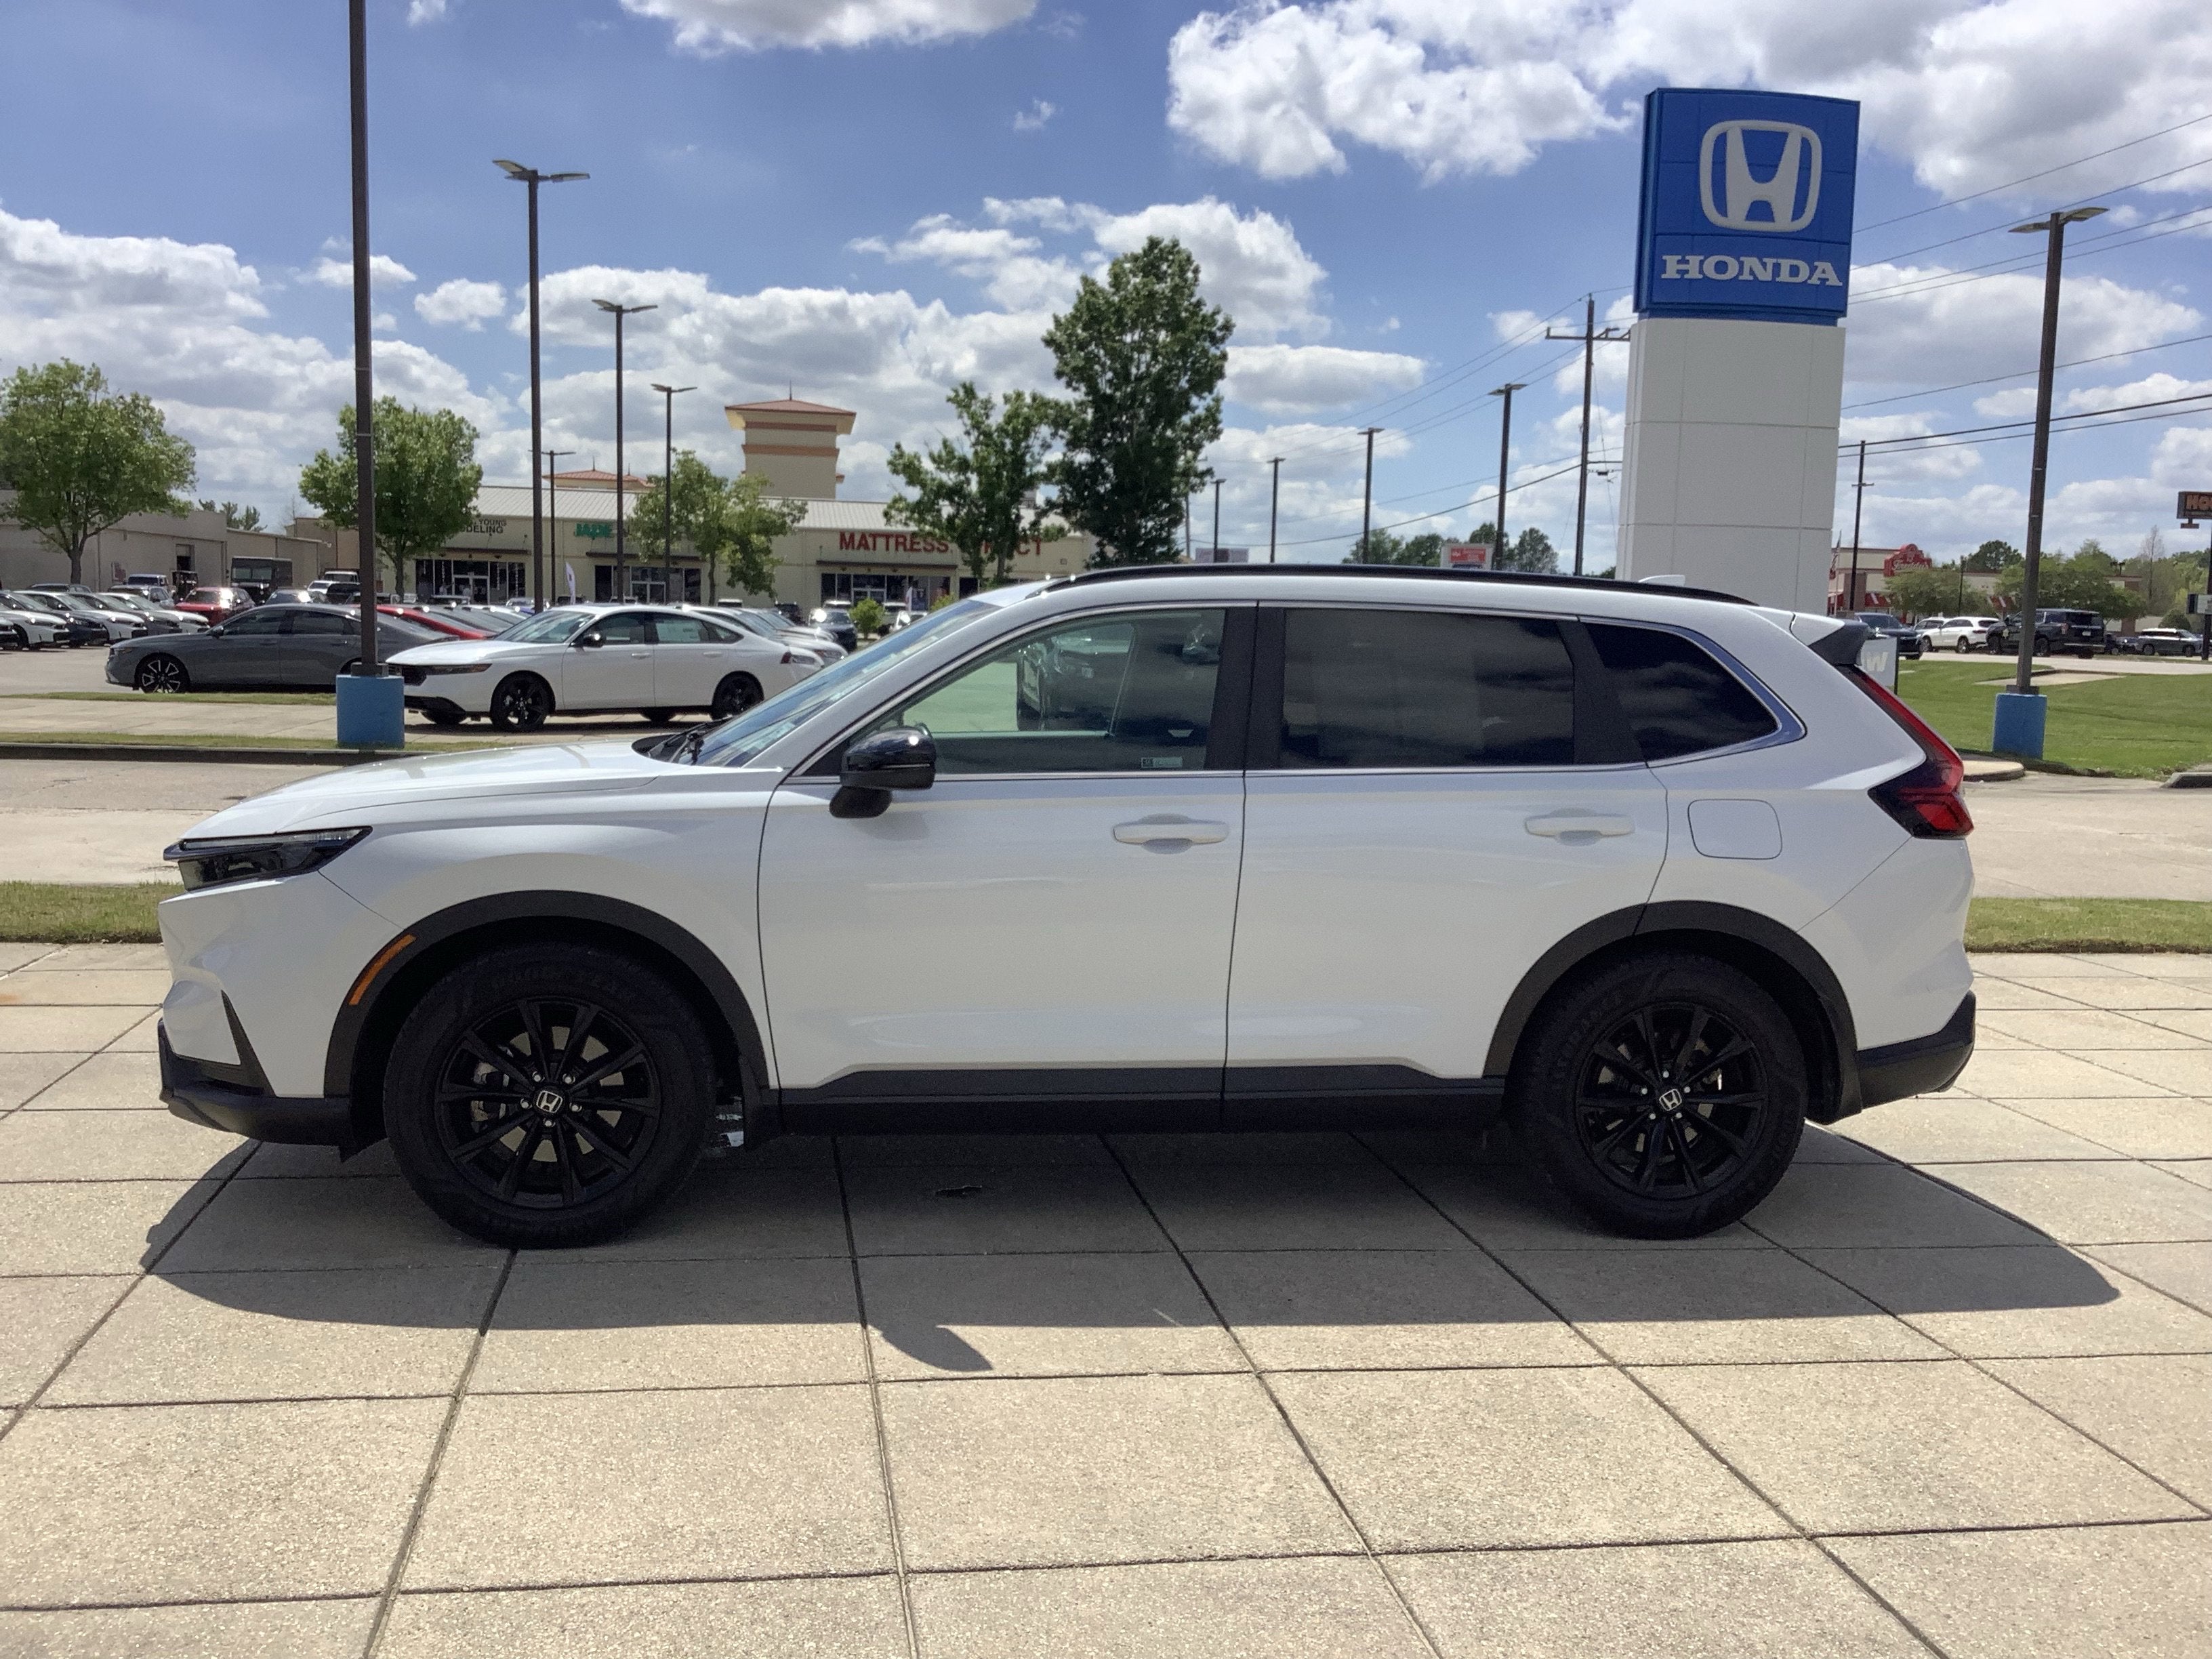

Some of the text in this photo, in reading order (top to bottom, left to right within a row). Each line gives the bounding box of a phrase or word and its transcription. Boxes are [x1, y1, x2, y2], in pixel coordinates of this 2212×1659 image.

[1661, 255, 1843, 286] HONDA
[461, 525, 504, 533] DELING
[478, 518, 507, 527] YOUNG
[840, 531, 949, 553] MATTRESS
